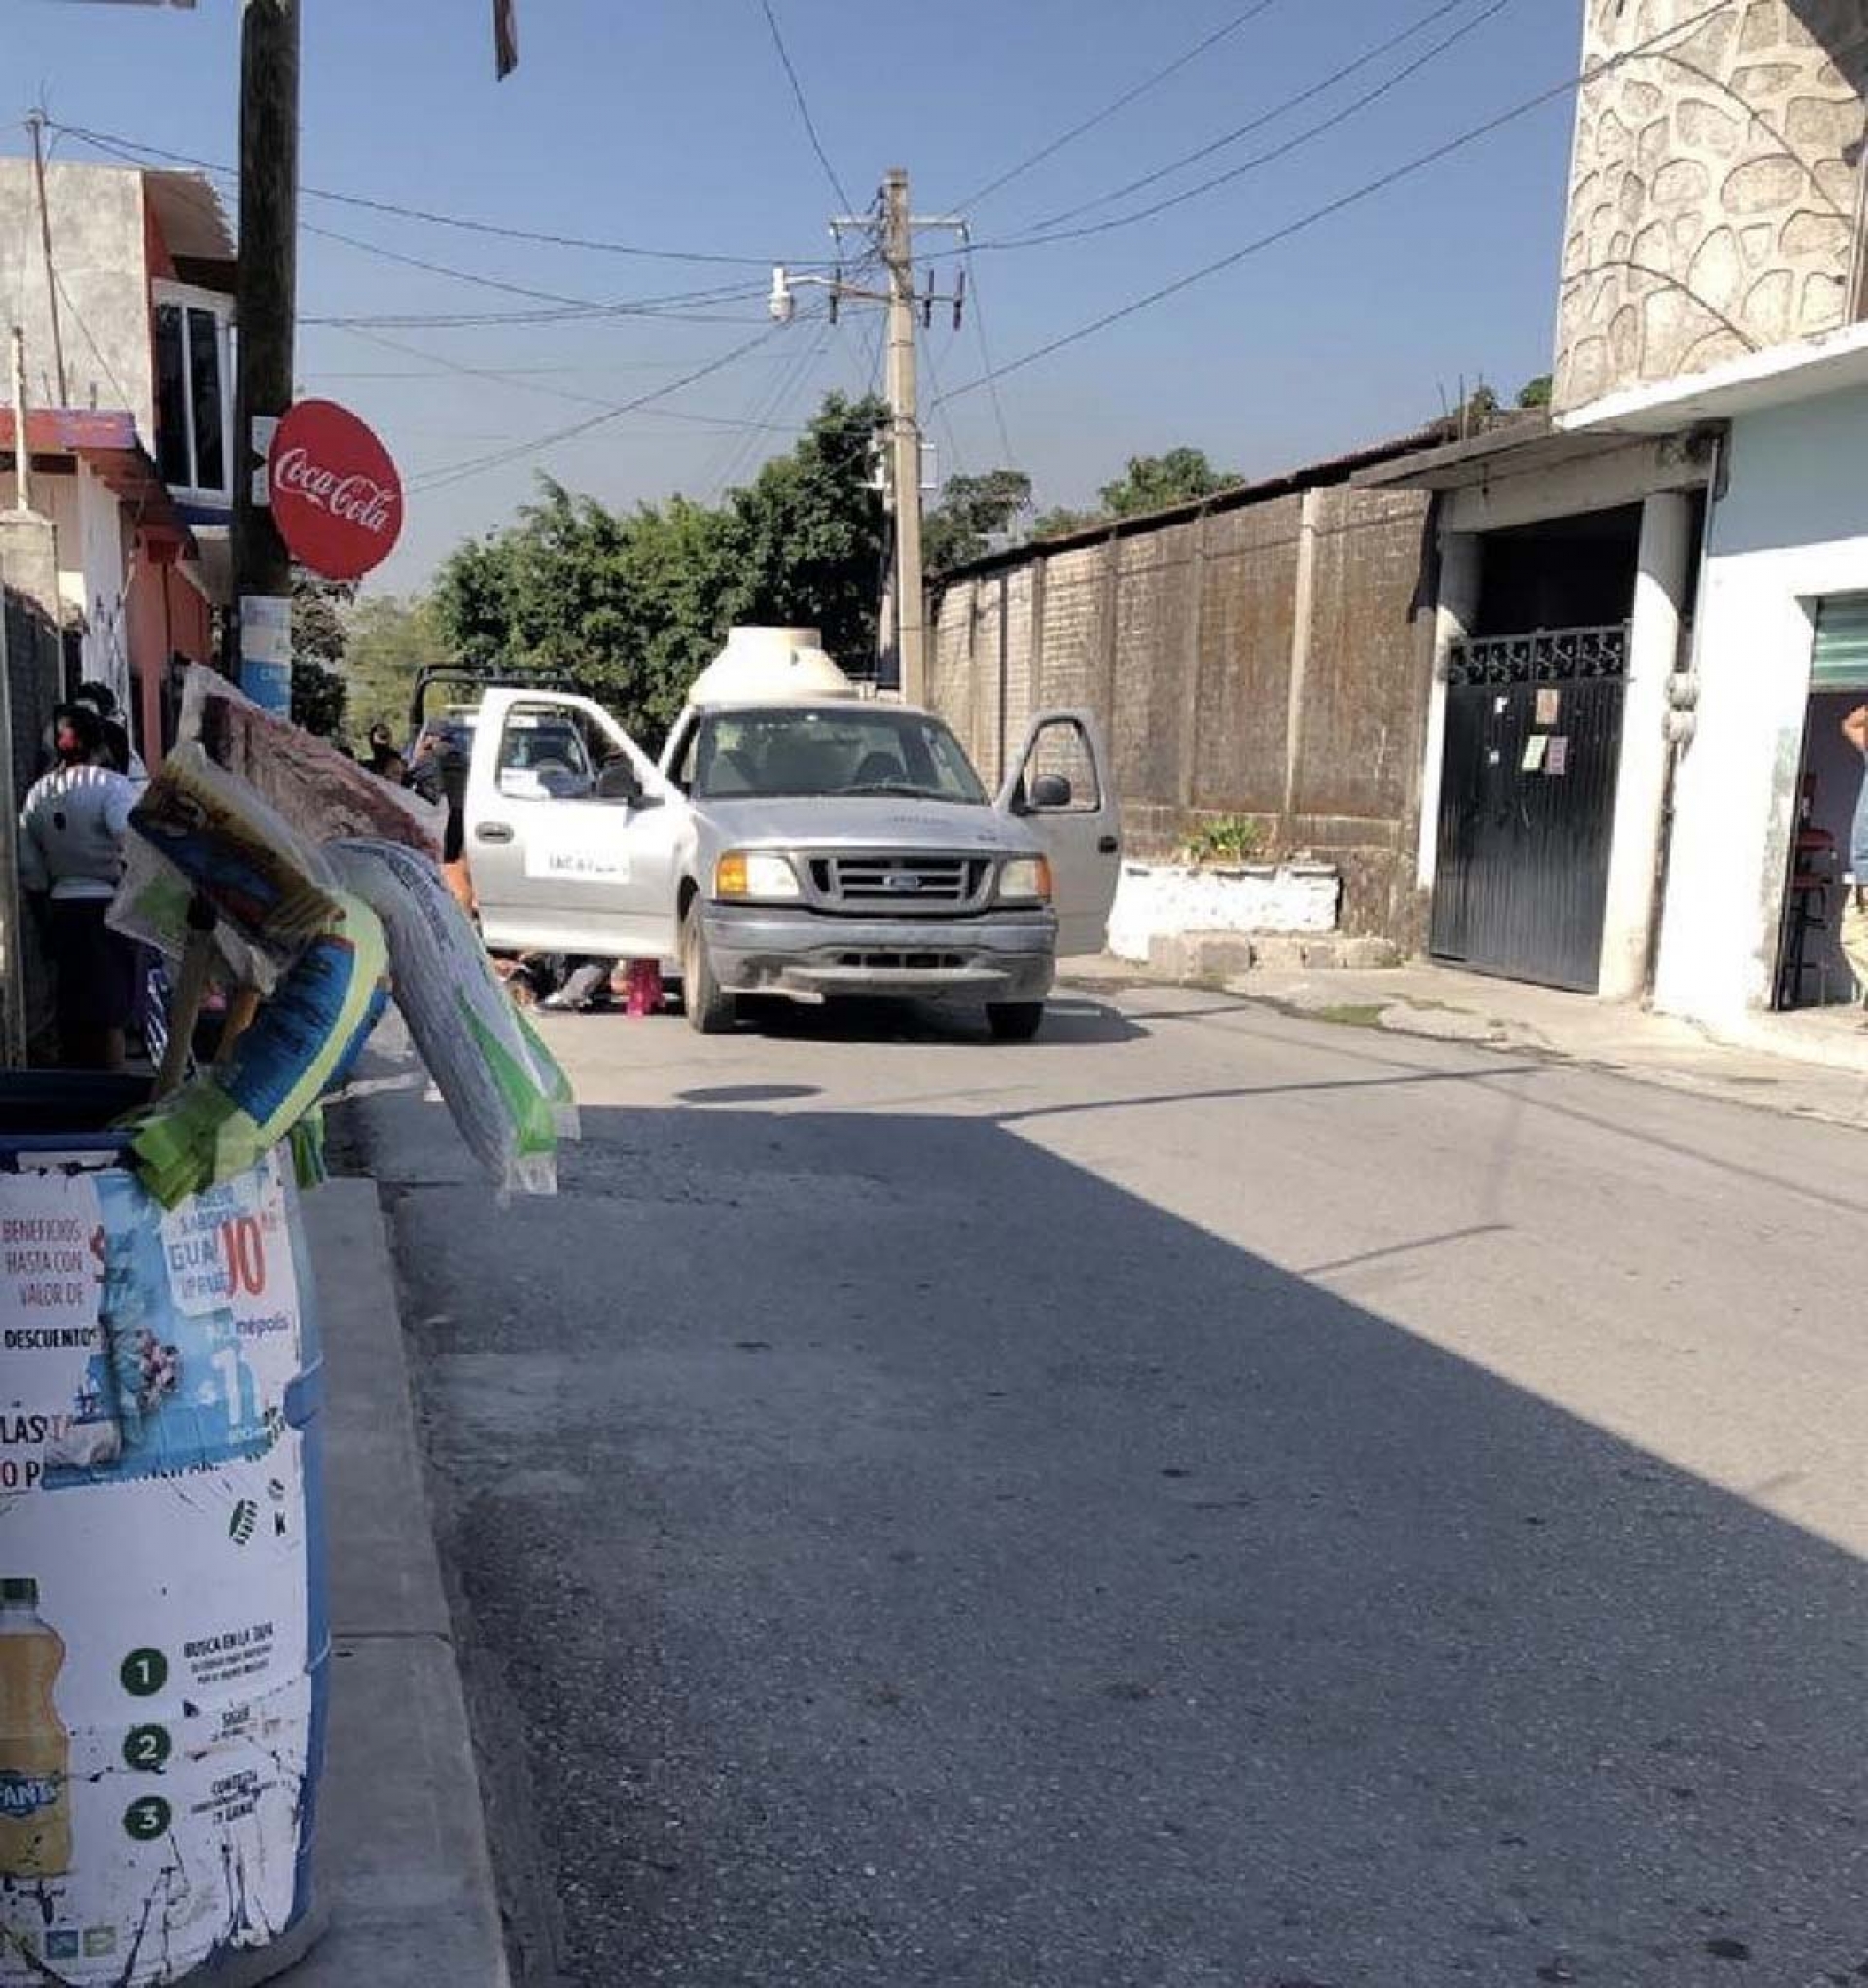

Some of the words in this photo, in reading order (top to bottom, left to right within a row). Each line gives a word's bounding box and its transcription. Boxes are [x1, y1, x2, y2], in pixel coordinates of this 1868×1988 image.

[136, 1659, 151, 1685] 1
[139, 1734, 157, 1760] 2
[139, 1804, 160, 1830] 3
